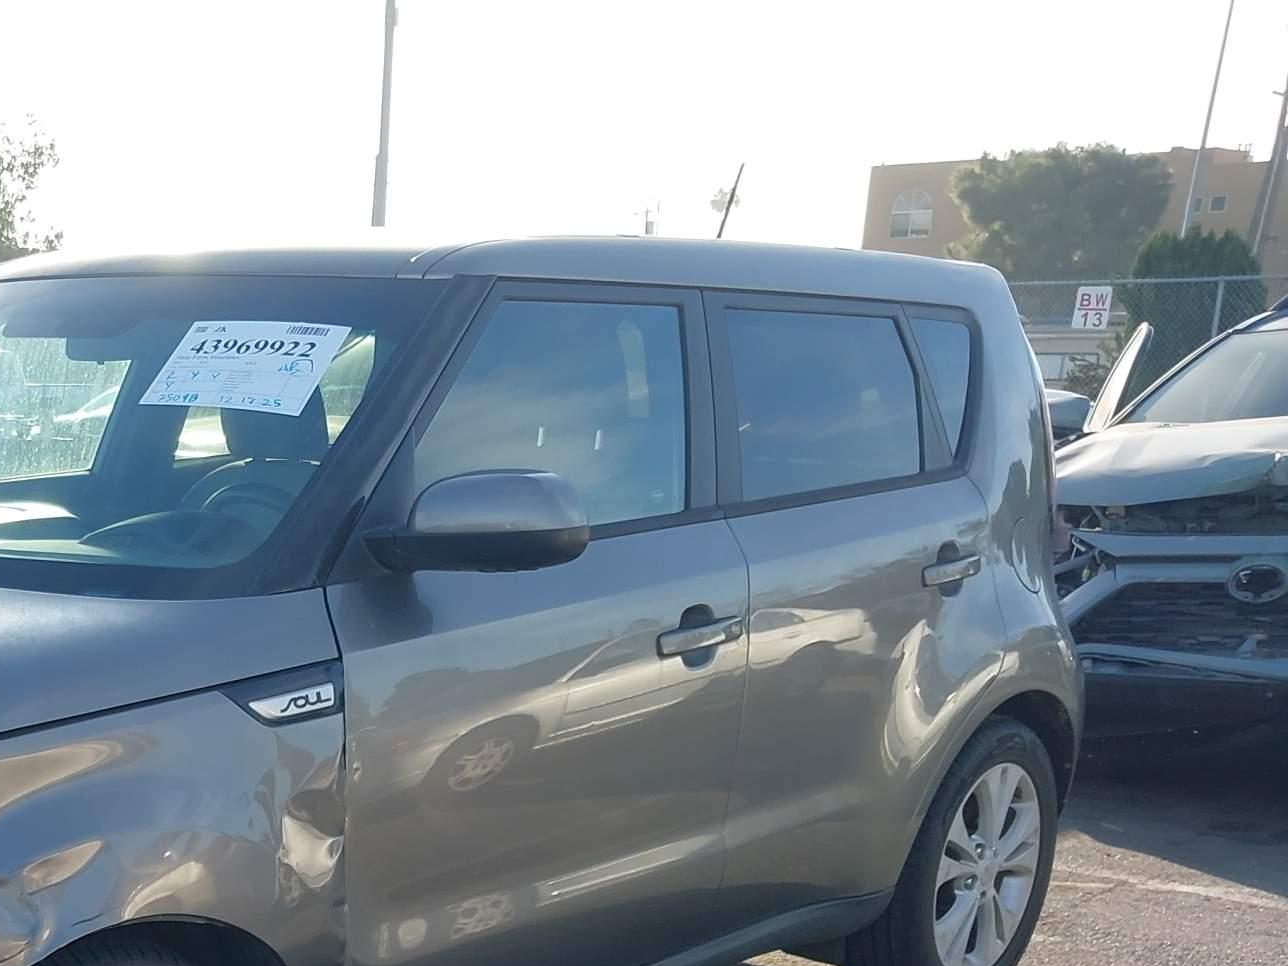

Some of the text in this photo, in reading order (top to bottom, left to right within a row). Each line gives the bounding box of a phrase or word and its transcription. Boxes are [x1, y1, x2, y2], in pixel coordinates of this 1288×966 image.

[1081, 311, 1103, 327] 13
[190, 338, 317, 358] 43969922
[280, 691, 332, 713] SOUL
